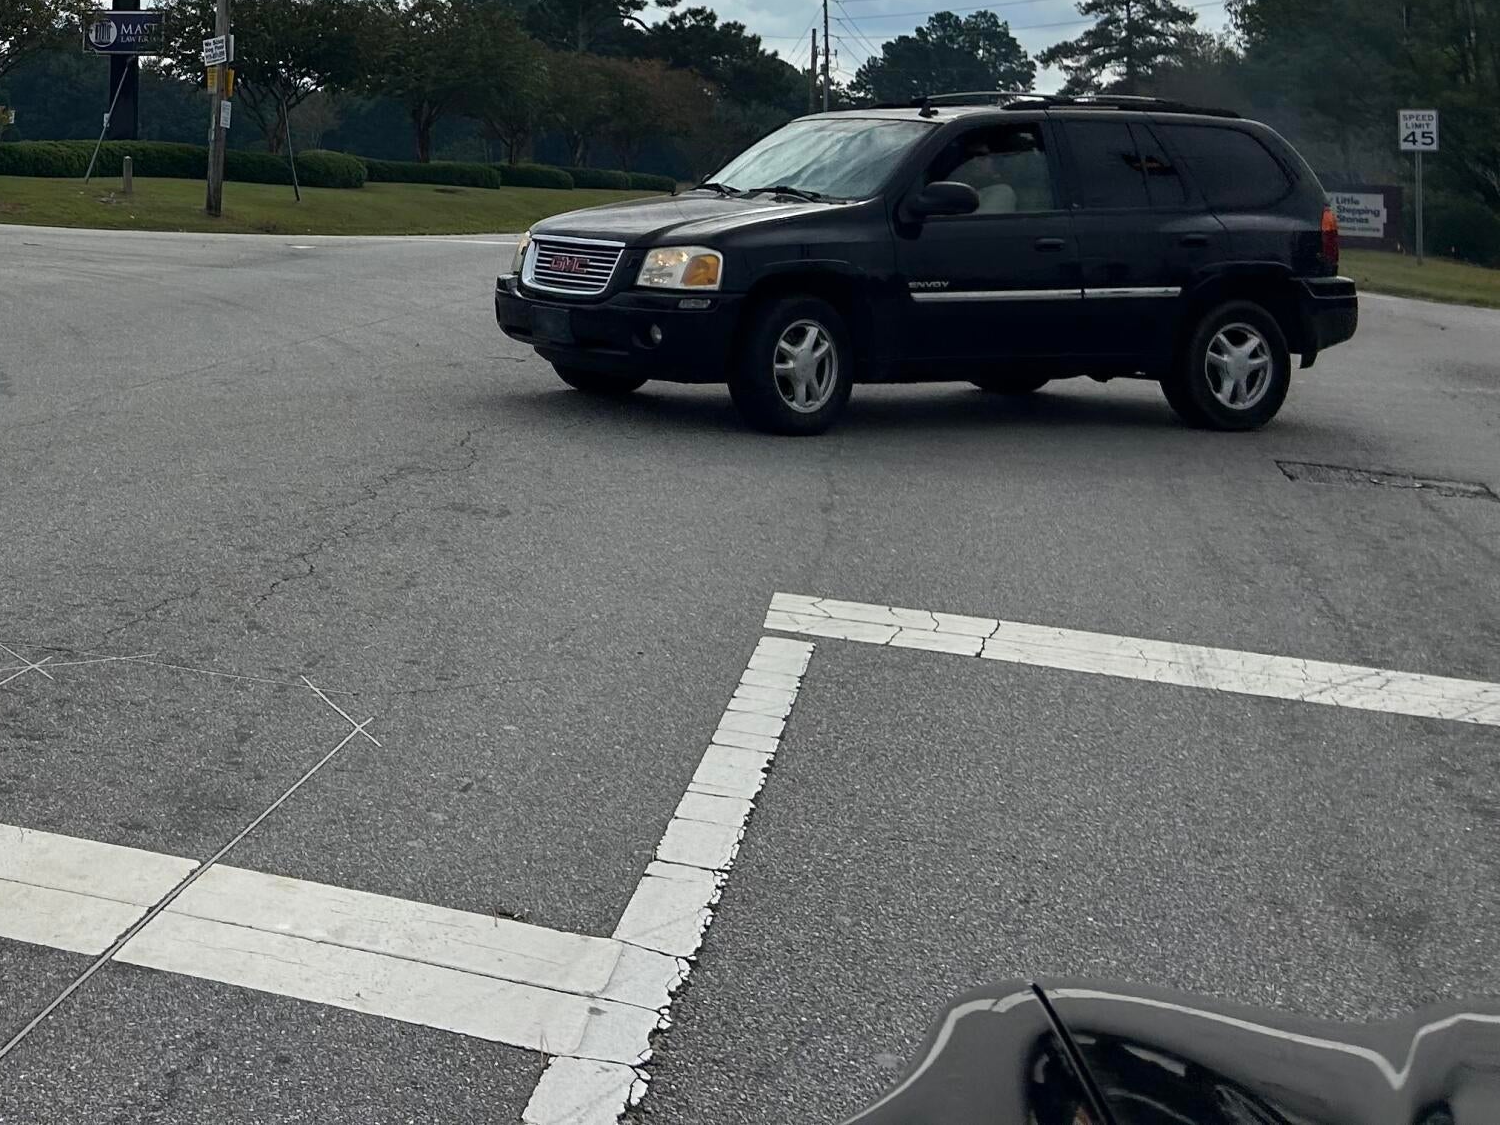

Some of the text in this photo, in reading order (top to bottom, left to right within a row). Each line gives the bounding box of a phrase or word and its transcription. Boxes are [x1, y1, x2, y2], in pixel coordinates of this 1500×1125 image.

[120, 35, 136, 43] LAW
[1402, 114, 1434, 122] SPEED
[1402, 131, 1435, 146] 45
[1336, 196, 1360, 205] Little
[1336, 205, 1380, 218] Stepping
[550, 256, 590, 273] GMC
